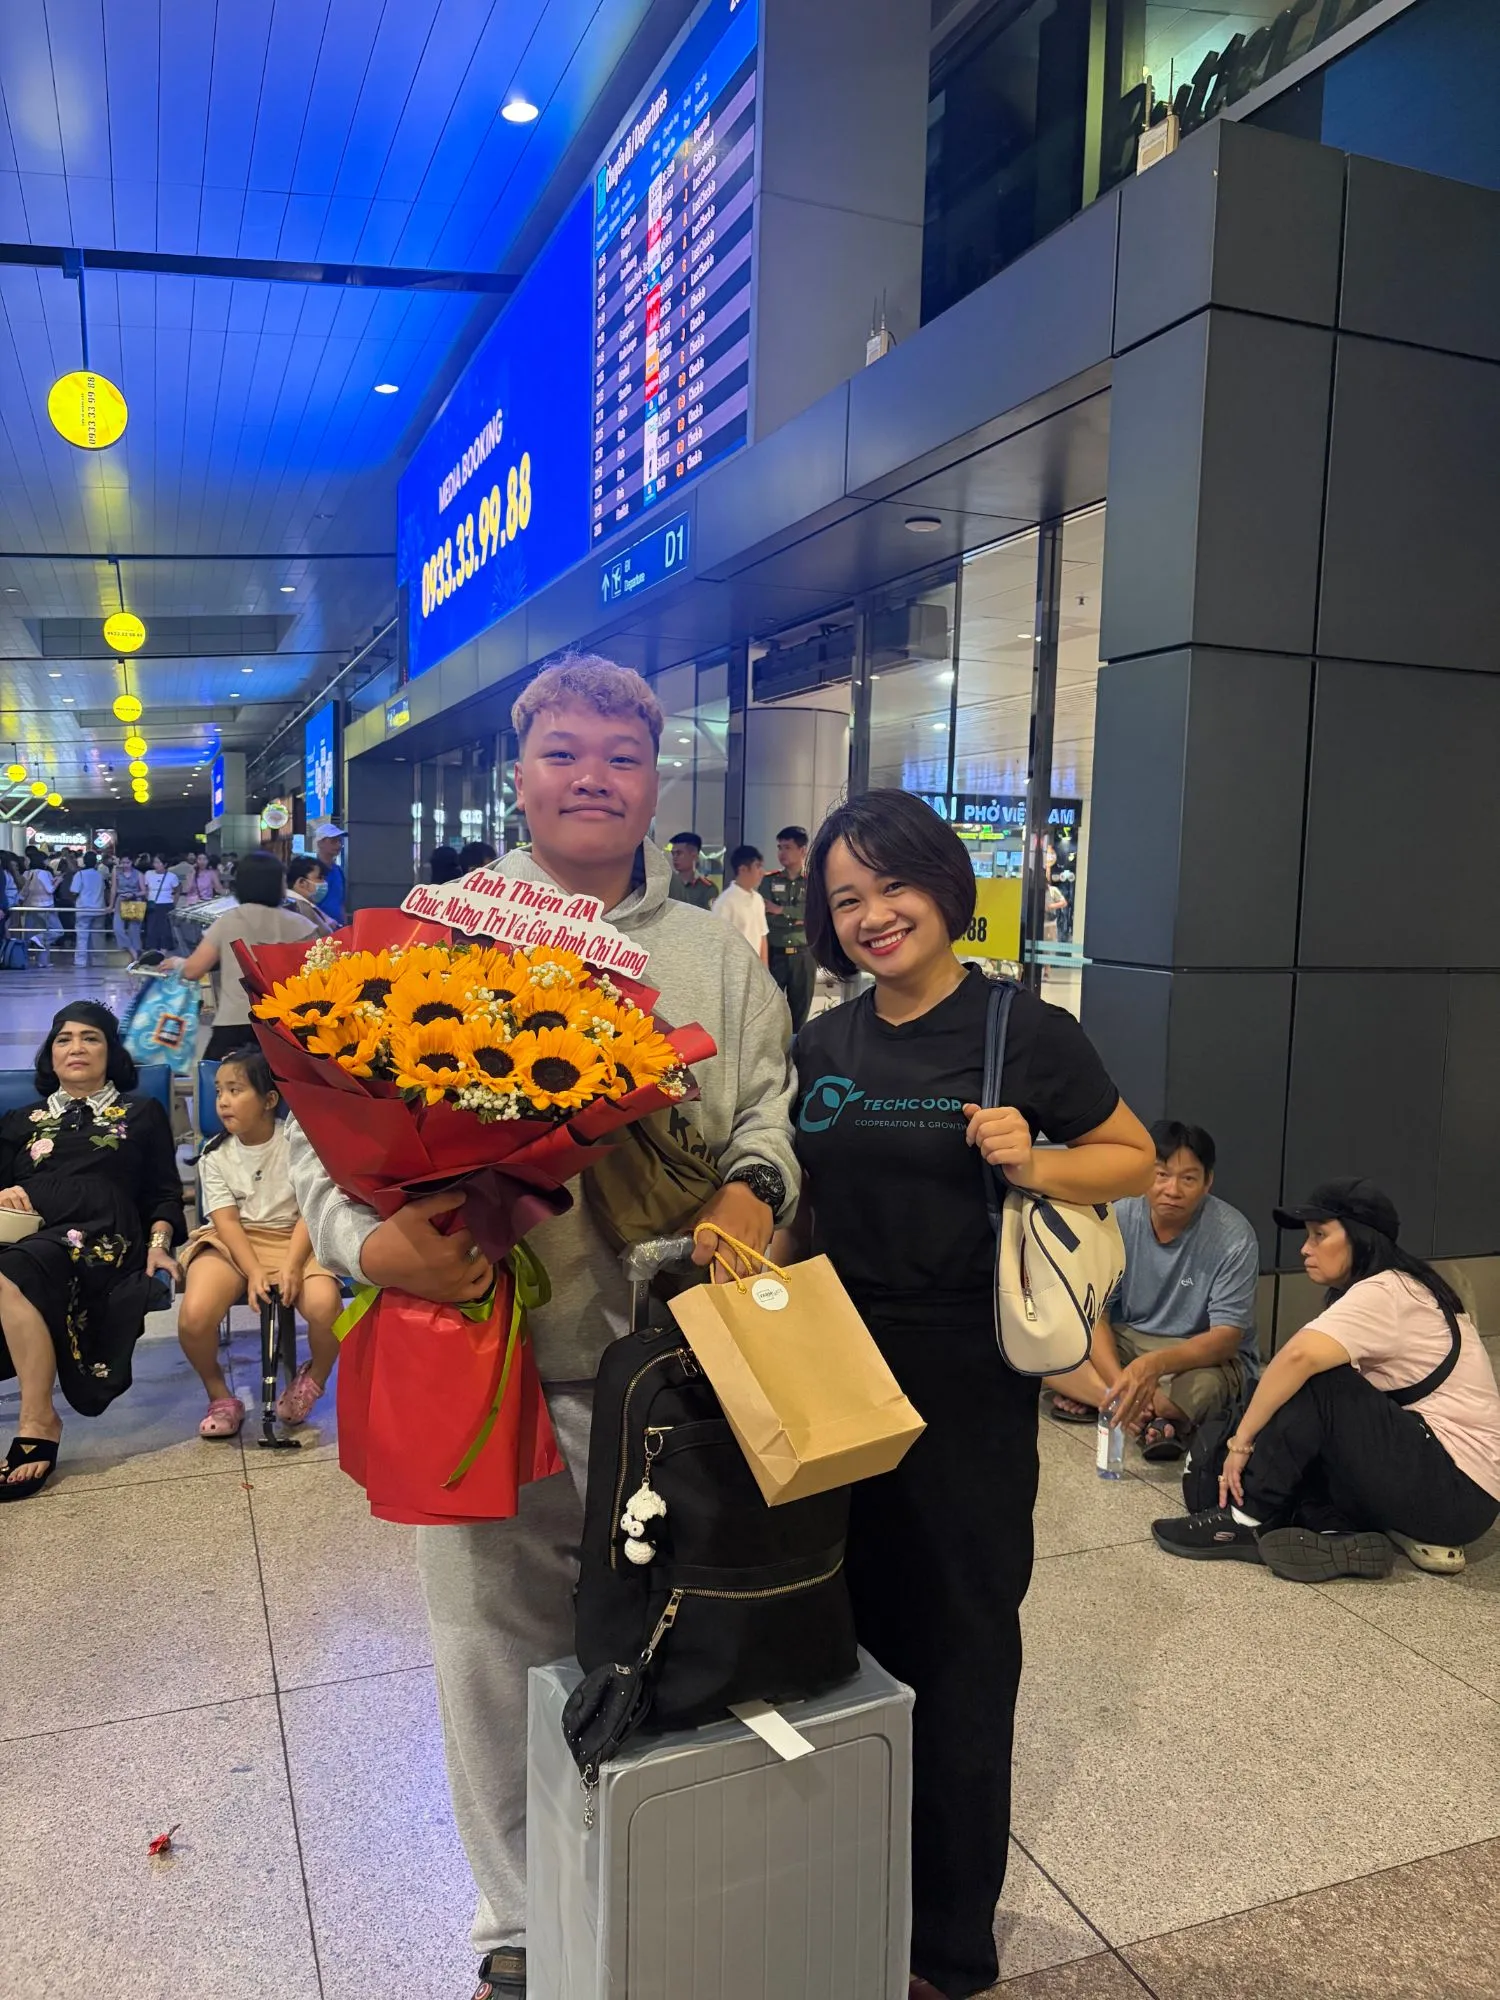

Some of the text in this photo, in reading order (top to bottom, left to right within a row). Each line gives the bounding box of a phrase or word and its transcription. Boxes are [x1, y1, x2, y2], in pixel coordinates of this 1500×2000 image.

[439, 408, 503, 515] MEDIA BOOKING
[422, 451, 532, 618] 0933.33.99.88
[665, 525, 684, 568] D1
[964, 799, 1001, 822] PHỞ
[1002, 801, 1027, 827] VIỆ
[1047, 807, 1076, 826] AM
[463, 871, 599, 923] Anh Thiện AM
[405, 887, 444, 918] Chúc
[440, 896, 484, 934] Mừng
[483, 907, 511, 935] Trí
[504, 912, 529, 941] Và
[526, 919, 553, 946] Gia
[551, 925, 588, 956] Đình
[585, 935, 615, 969] Chị
[855, 1119, 916, 1129] COOPERATION
[919, 1120, 927, 1129] &
[863, 1097, 963, 1112] TECHCOOP
